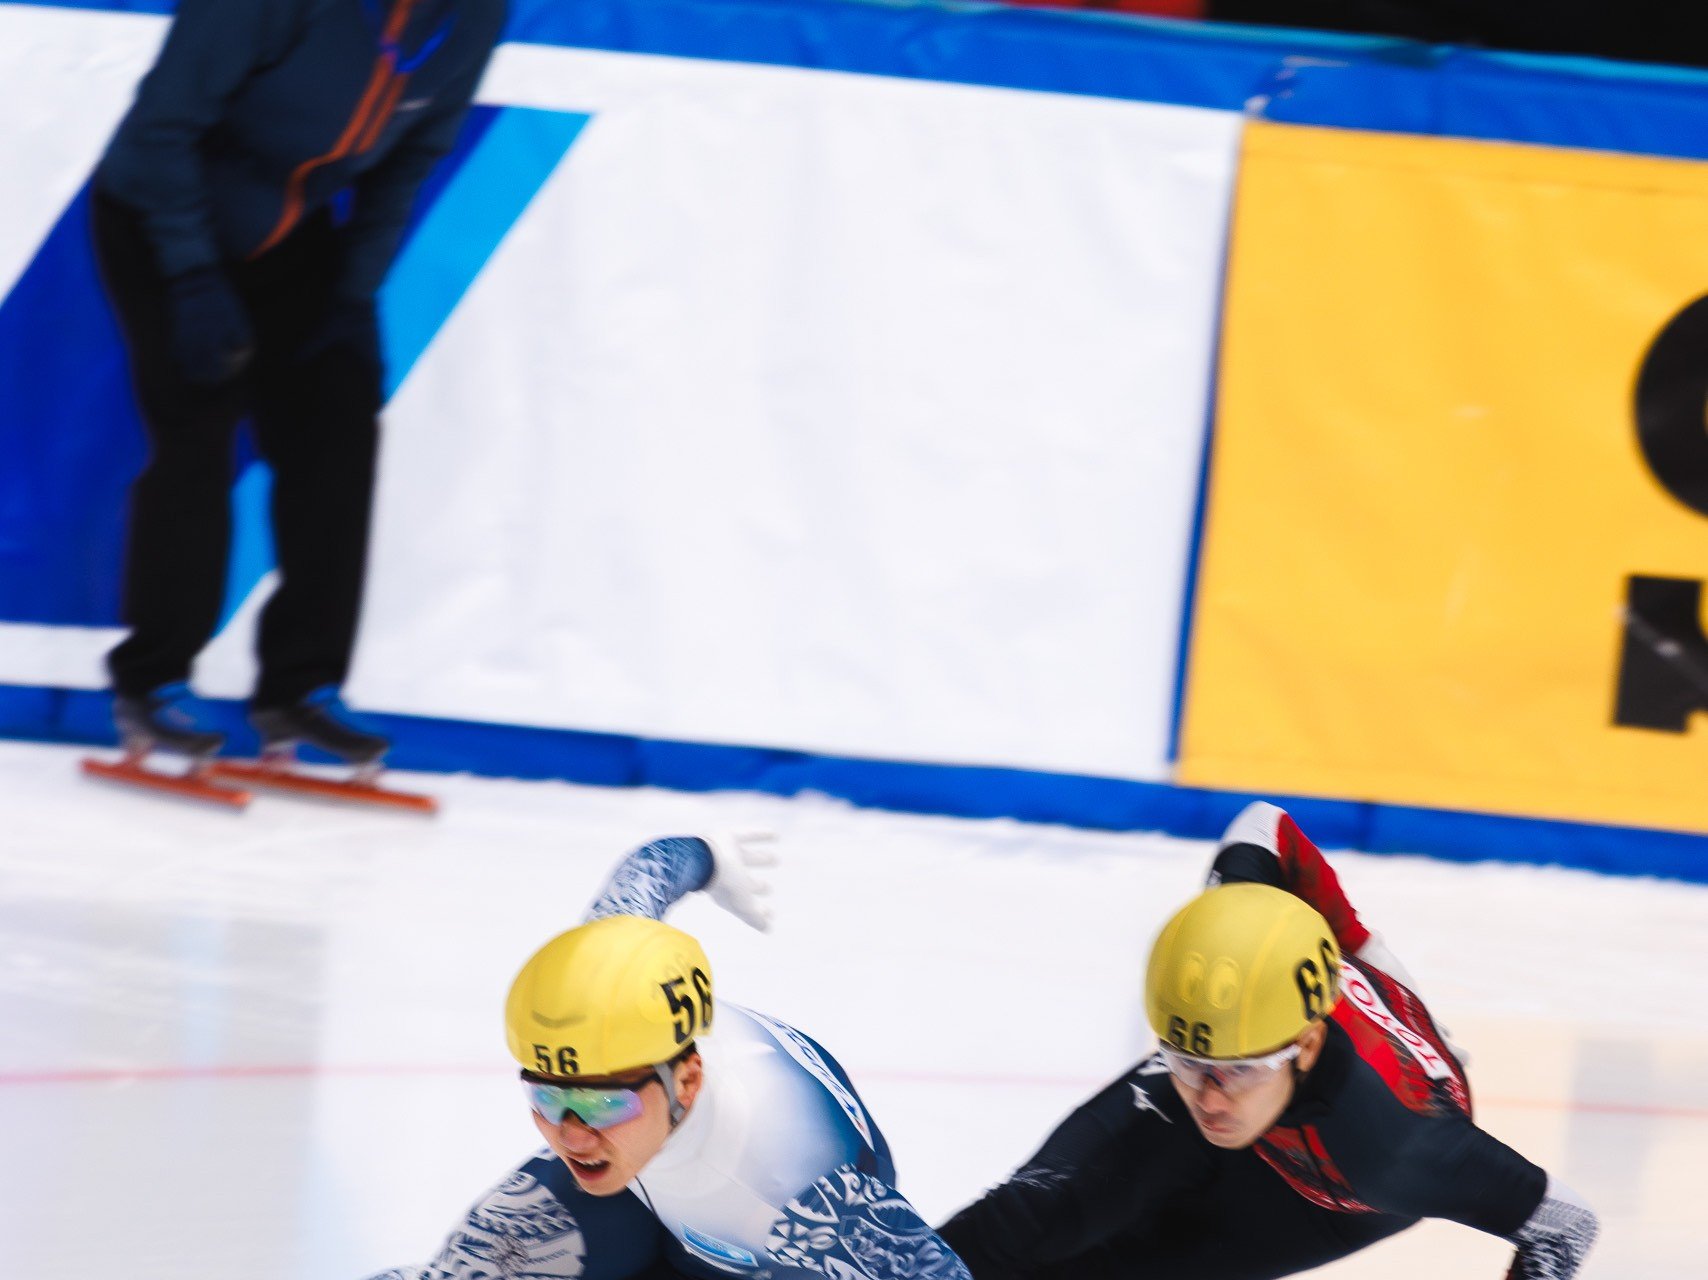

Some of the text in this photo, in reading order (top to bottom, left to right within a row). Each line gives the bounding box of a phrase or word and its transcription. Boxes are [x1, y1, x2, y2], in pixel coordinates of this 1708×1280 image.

[659, 966, 713, 1044] 56
[1168, 1015, 1213, 1055] 66
[532, 1043, 580, 1075] 56
